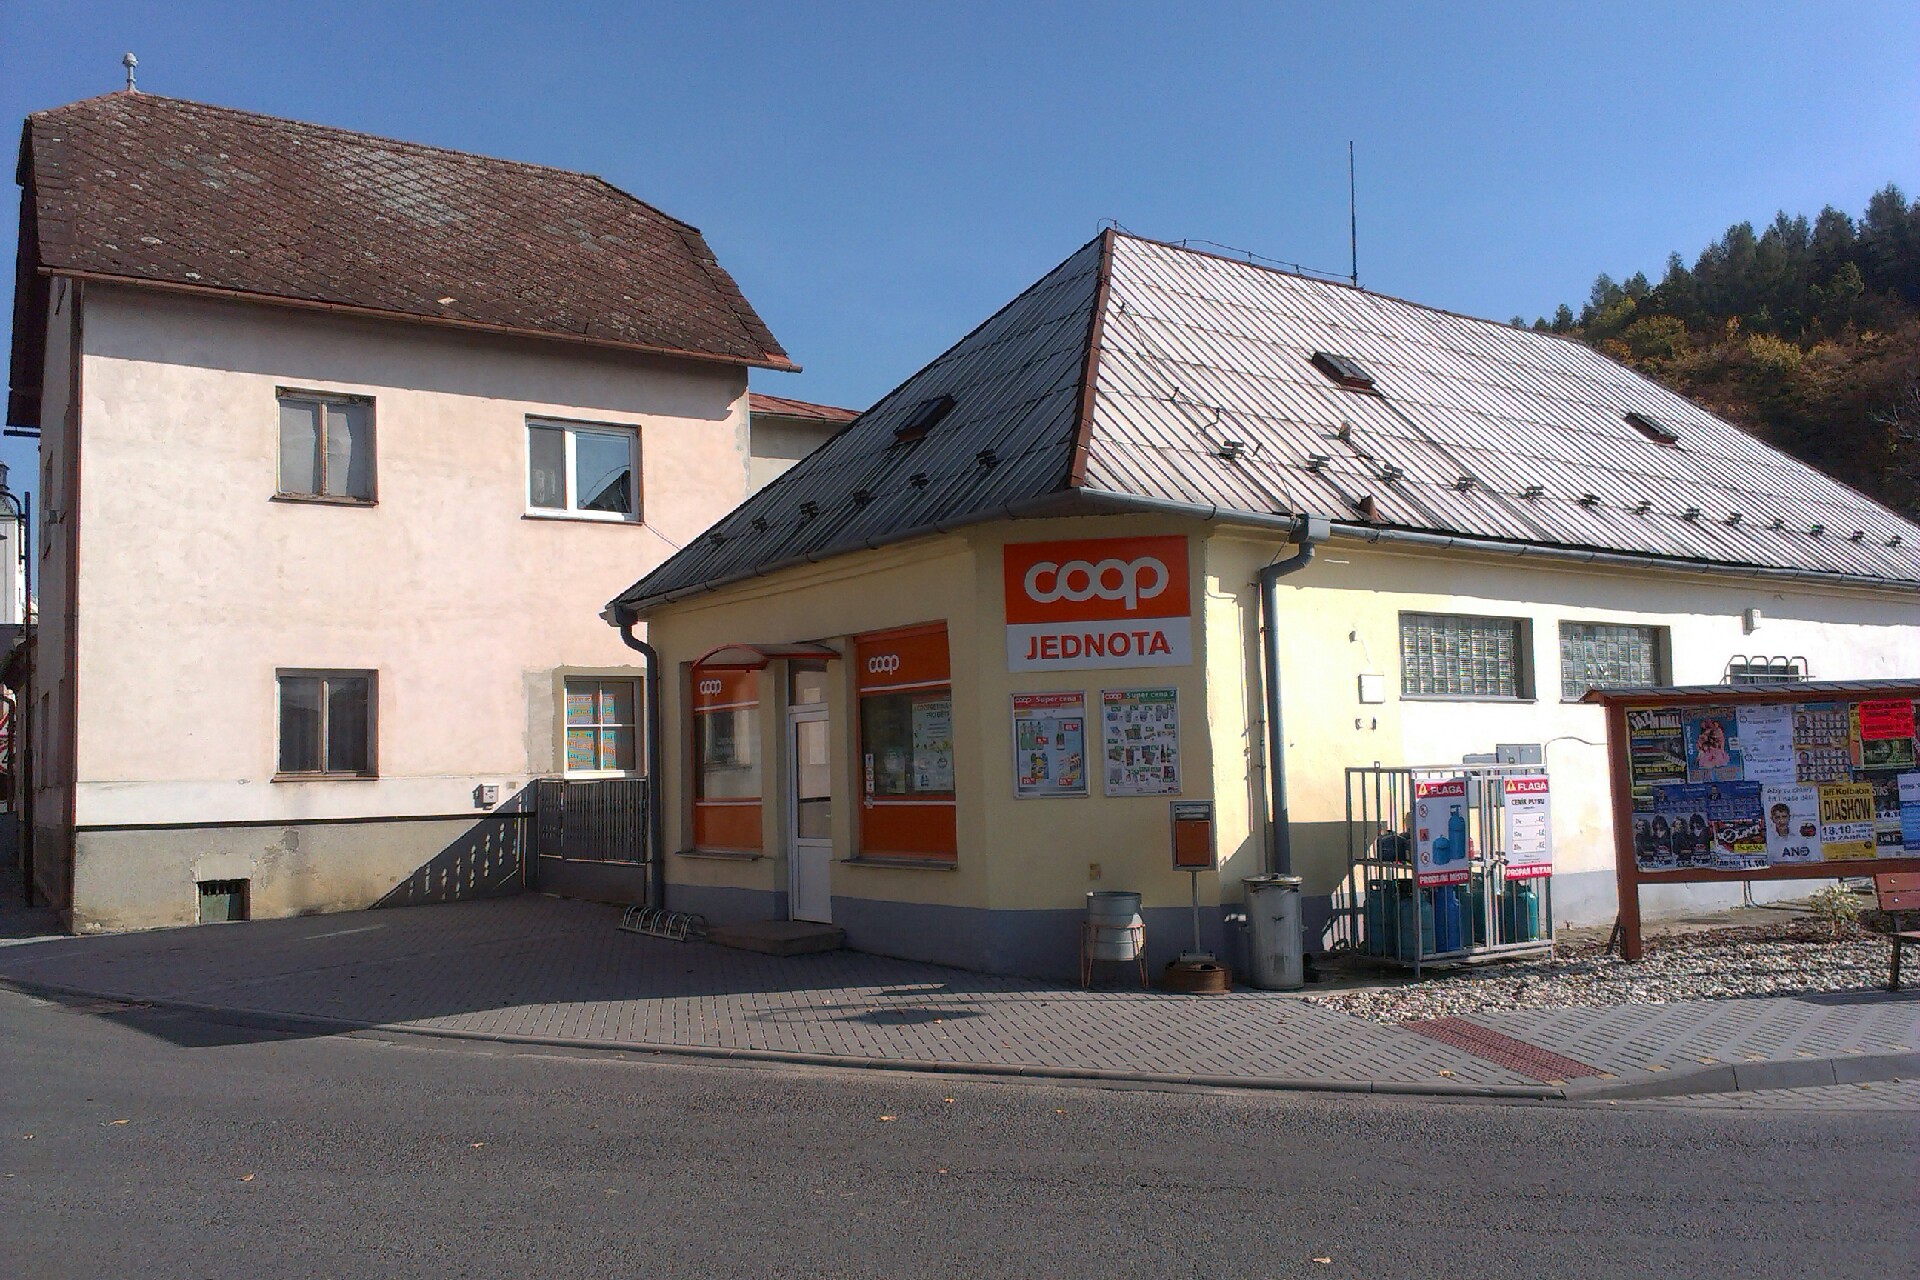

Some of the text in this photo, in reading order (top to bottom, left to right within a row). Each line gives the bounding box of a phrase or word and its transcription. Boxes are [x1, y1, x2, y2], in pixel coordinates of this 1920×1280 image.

[1024, 556, 1170, 611] coop
[1026, 630, 1171, 660] JEDNOTA
[868, 654, 900, 675] coop
[699, 679, 722, 696] coop
[1126, 692, 1149, 700] Super
[1035, 696, 1058, 705] Super
[1429, 785, 1463, 795] FLAGA
[1517, 782, 1547, 791] FLAGA
[1823, 798, 1871, 821] DIASHOW
